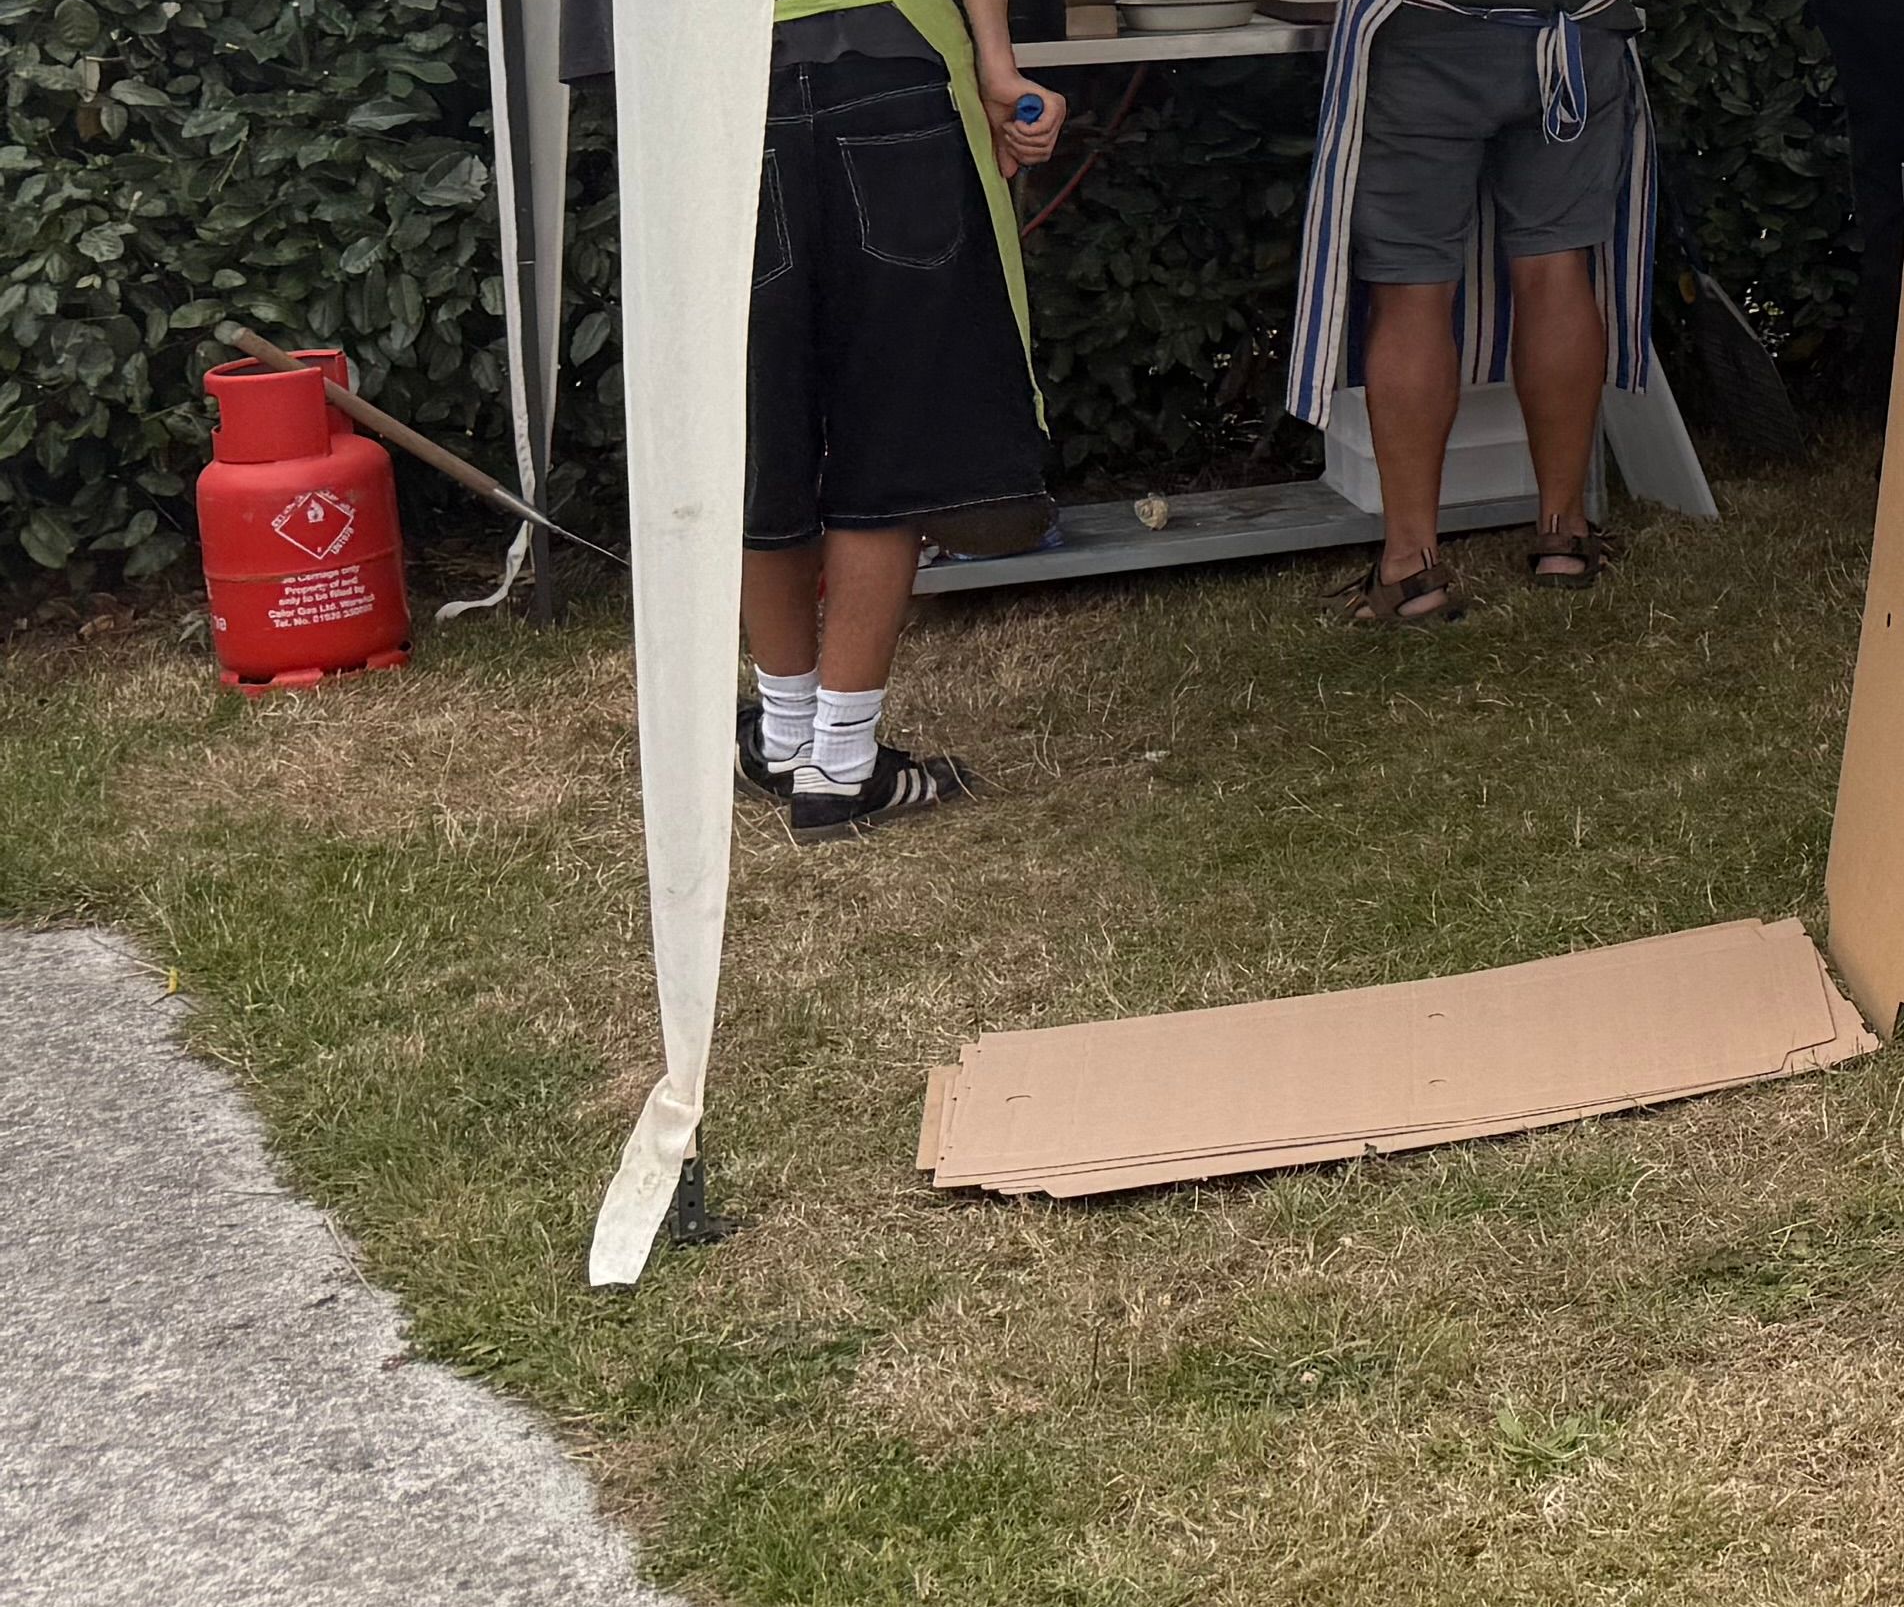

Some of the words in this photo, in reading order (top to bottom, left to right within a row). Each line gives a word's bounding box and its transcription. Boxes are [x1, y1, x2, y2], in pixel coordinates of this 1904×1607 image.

[284, 583, 328, 596] Property
[330, 579, 340, 589] of
[278, 596, 300, 607] only
[303, 594, 314, 603] to
[315, 592, 328, 602] be
[268, 607, 295, 619] Calor
[297, 606, 317, 616] Gas
